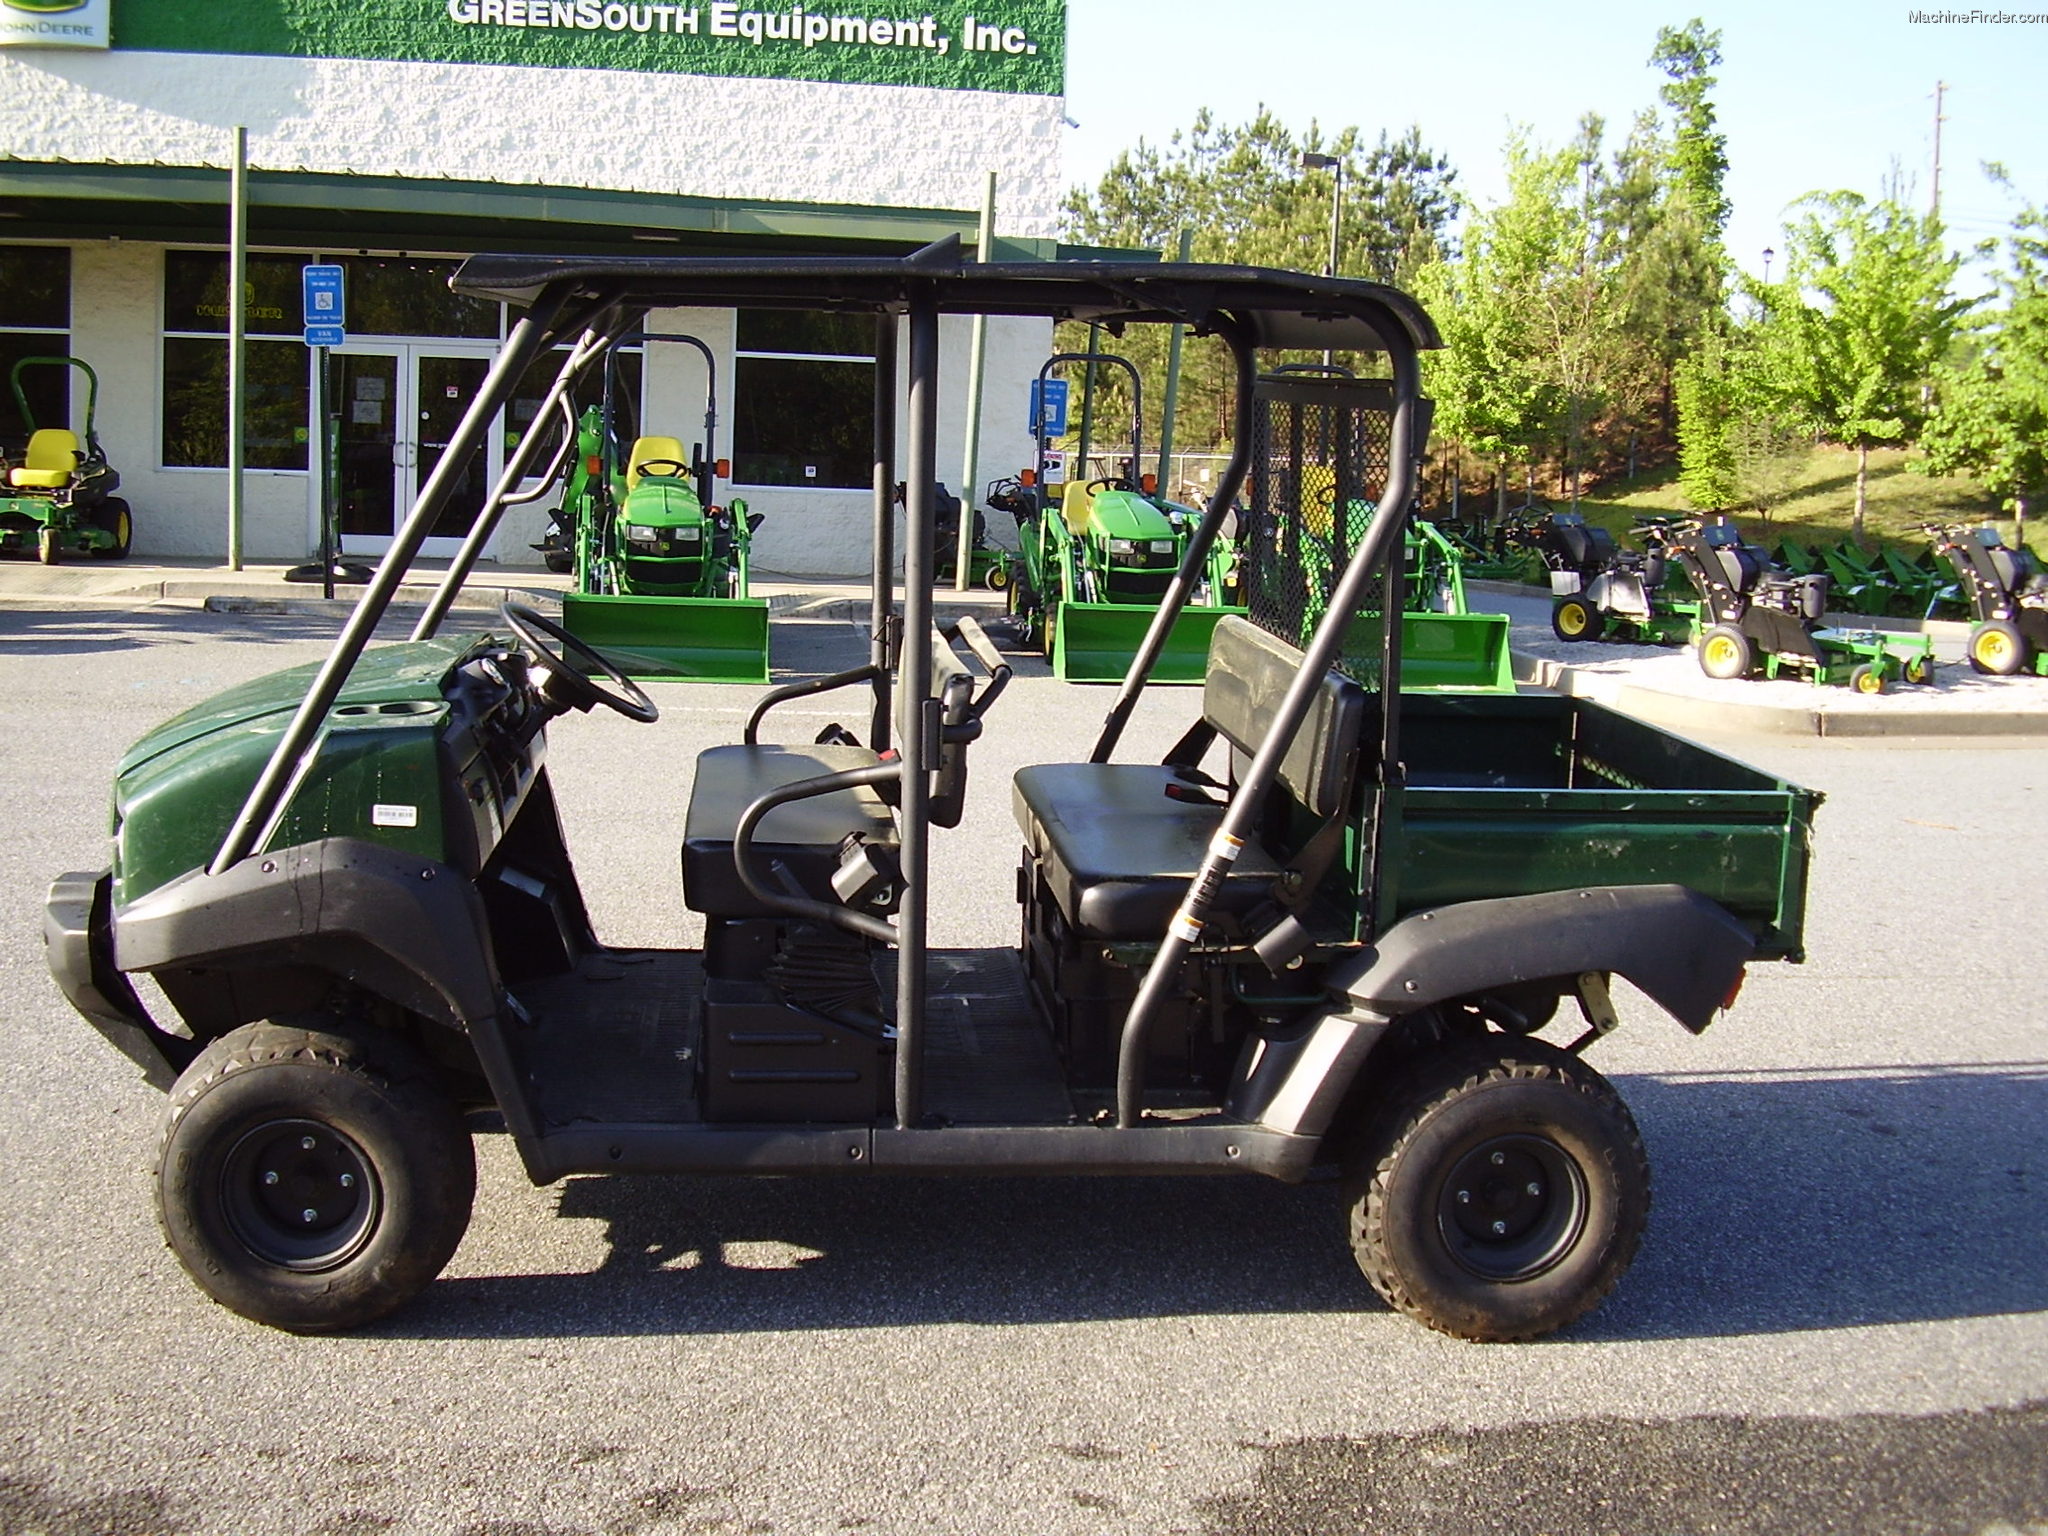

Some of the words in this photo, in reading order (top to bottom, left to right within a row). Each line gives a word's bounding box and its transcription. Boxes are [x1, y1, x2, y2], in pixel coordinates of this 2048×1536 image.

[38, 21, 95, 36] DEERE
[448, 0, 699, 35] GREENSOUTH
[710, 2, 949, 56] Equipment,
[962, 16, 1038, 55] Inc.
